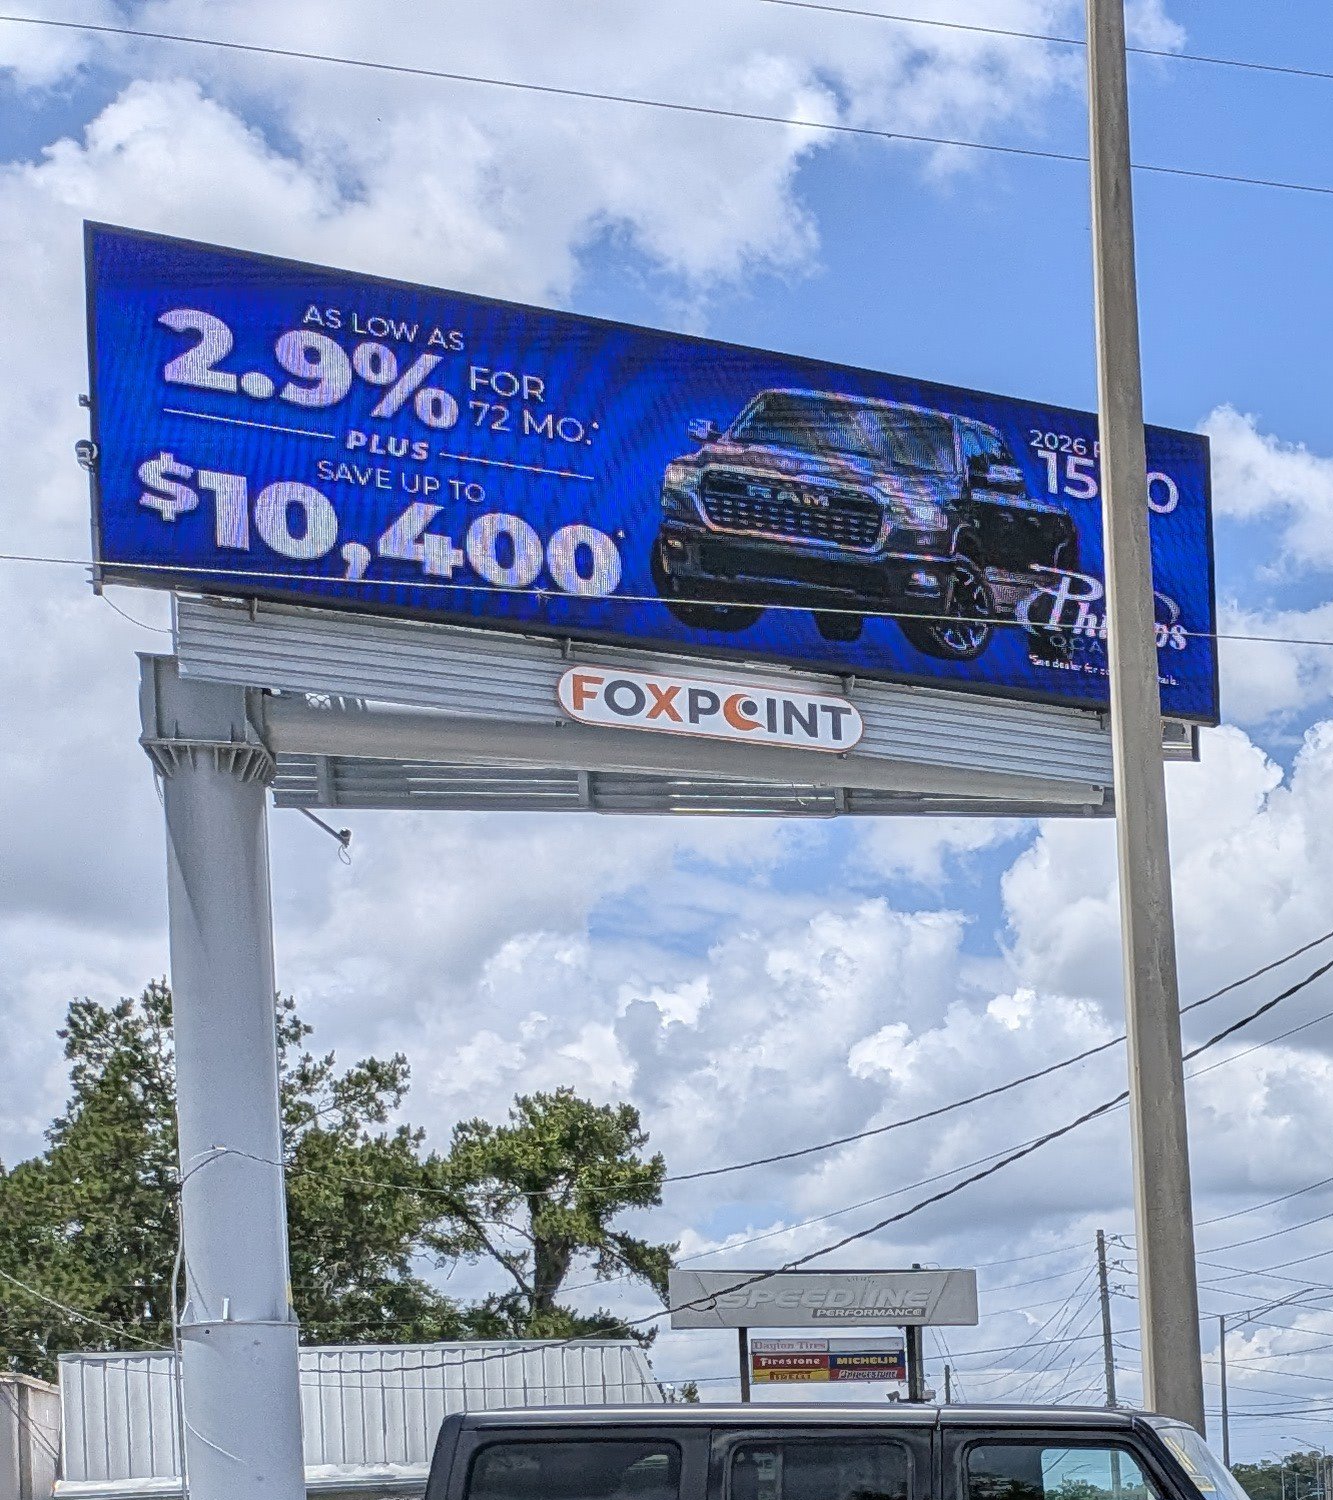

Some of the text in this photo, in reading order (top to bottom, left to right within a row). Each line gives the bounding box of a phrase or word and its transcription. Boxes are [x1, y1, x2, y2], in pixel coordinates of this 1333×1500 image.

[303, 305, 465, 351] AS LOW AS
[157, 307, 459, 429] 2.9%
[469, 365, 545, 402] FOR
[469, 400, 511, 432] 72
[346, 429, 430, 461] PLUS
[1029, 428, 1087, 456] 2026
[317, 460, 486, 503] SAVE UP TO
[1037, 448, 1180, 514] 150
[571, 673, 852, 741] FOXPOINT
[815, 1307, 922, 1319] PERFORMANCE
[753, 1341, 826, 1351] Dayton Tires
[759, 1357, 821, 1366] Firestone
[836, 1356, 898, 1365] MICHELIN
